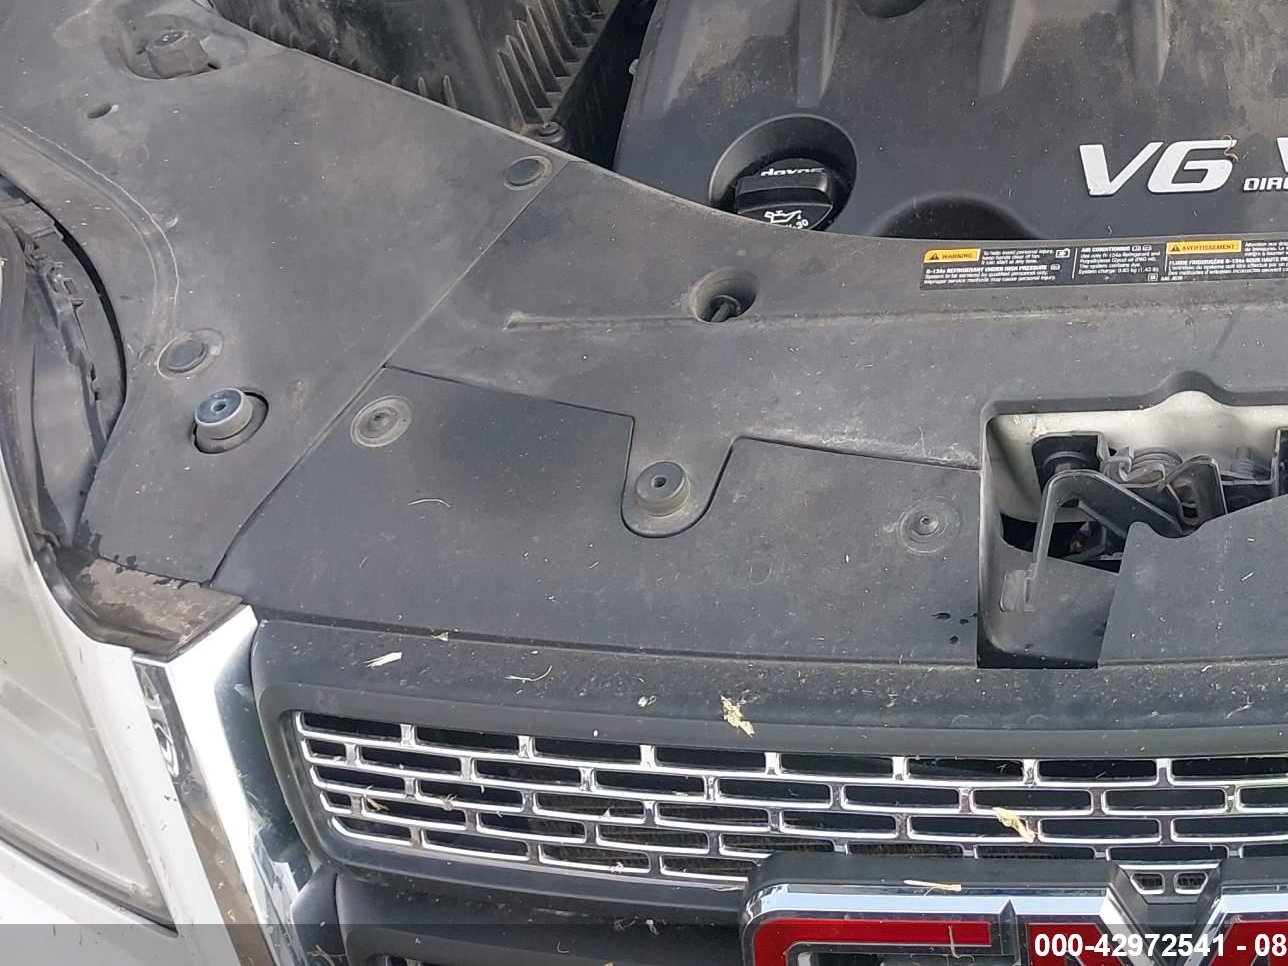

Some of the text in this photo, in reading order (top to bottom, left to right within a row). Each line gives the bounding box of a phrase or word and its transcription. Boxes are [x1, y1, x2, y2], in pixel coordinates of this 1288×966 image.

[1079, 139, 1238, 196] V6
[1181, 243, 1235, 252] AVERTISSEMENT
[941, 252, 973, 260] WARNING
